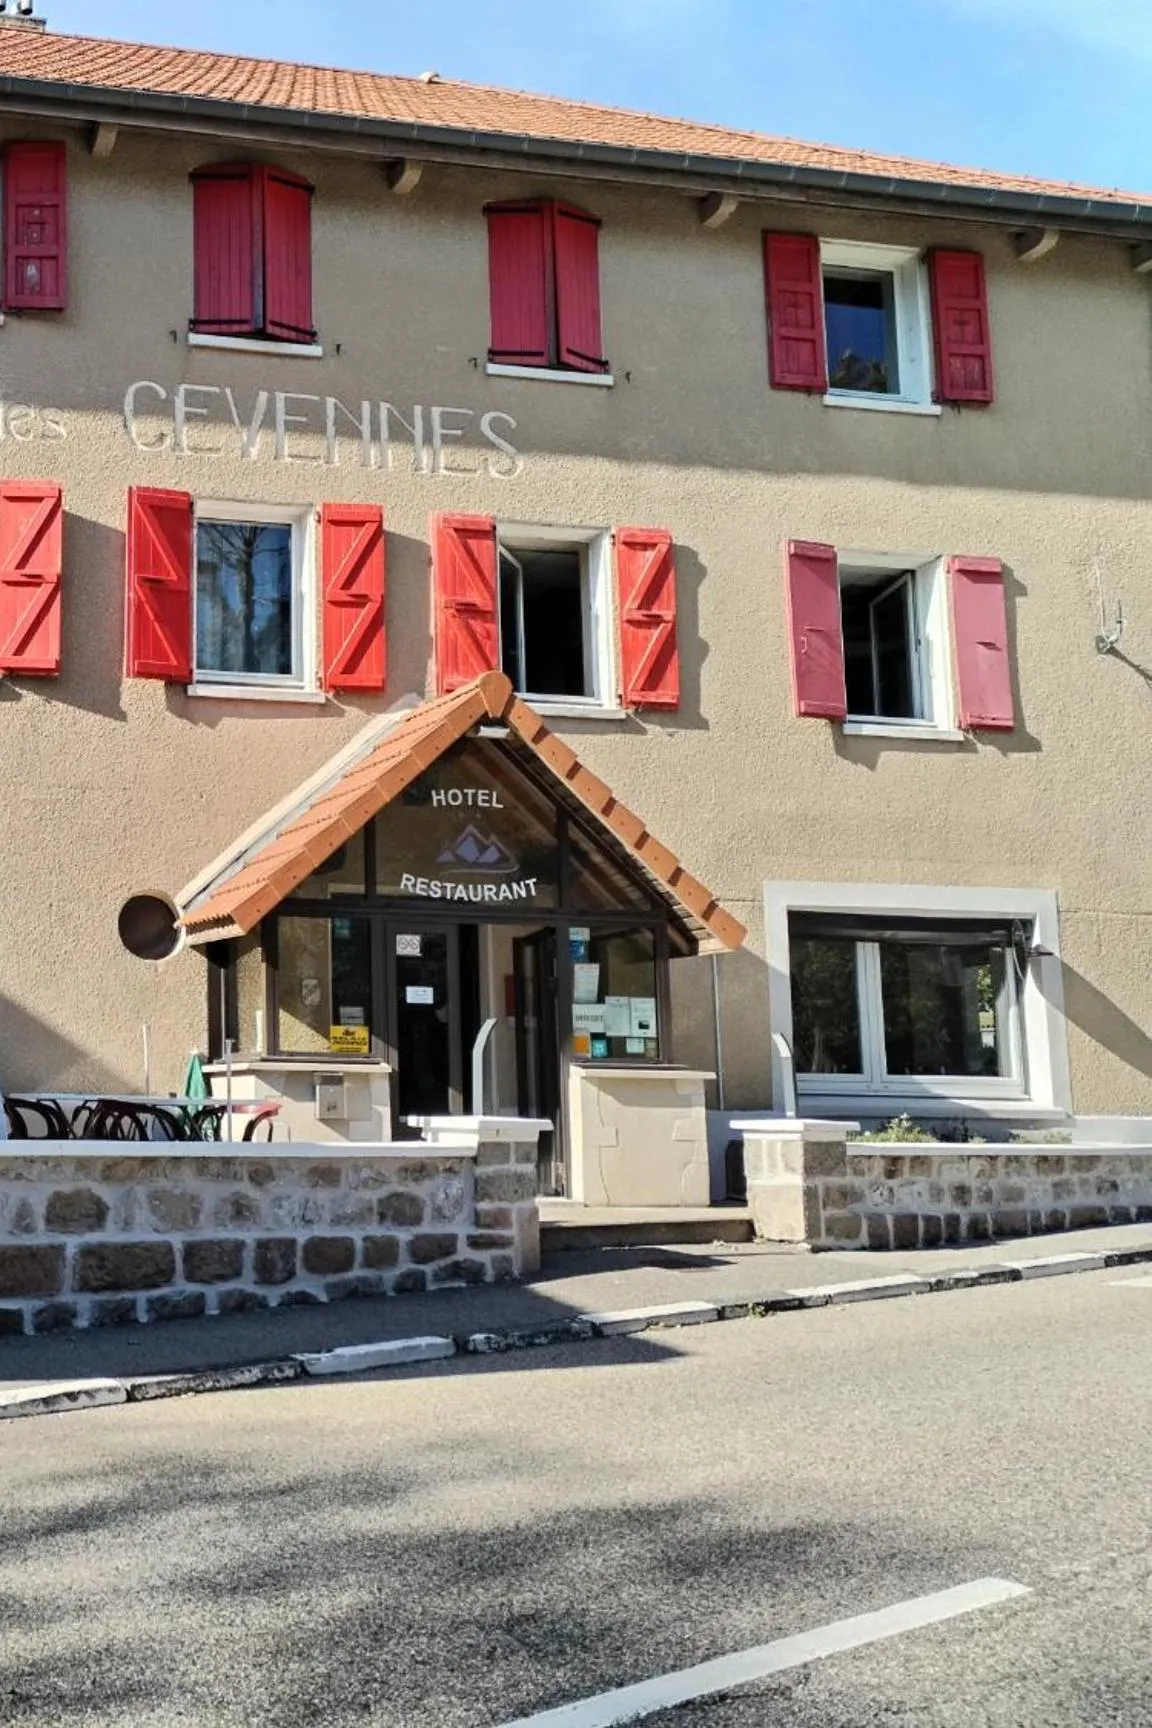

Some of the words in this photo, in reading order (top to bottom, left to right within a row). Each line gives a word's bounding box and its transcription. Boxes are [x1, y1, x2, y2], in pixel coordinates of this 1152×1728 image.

[123, 380, 525, 482] CEVENNES
[431, 788, 504, 809] HOTEL
[400, 872, 538, 902] RESTAURANT
